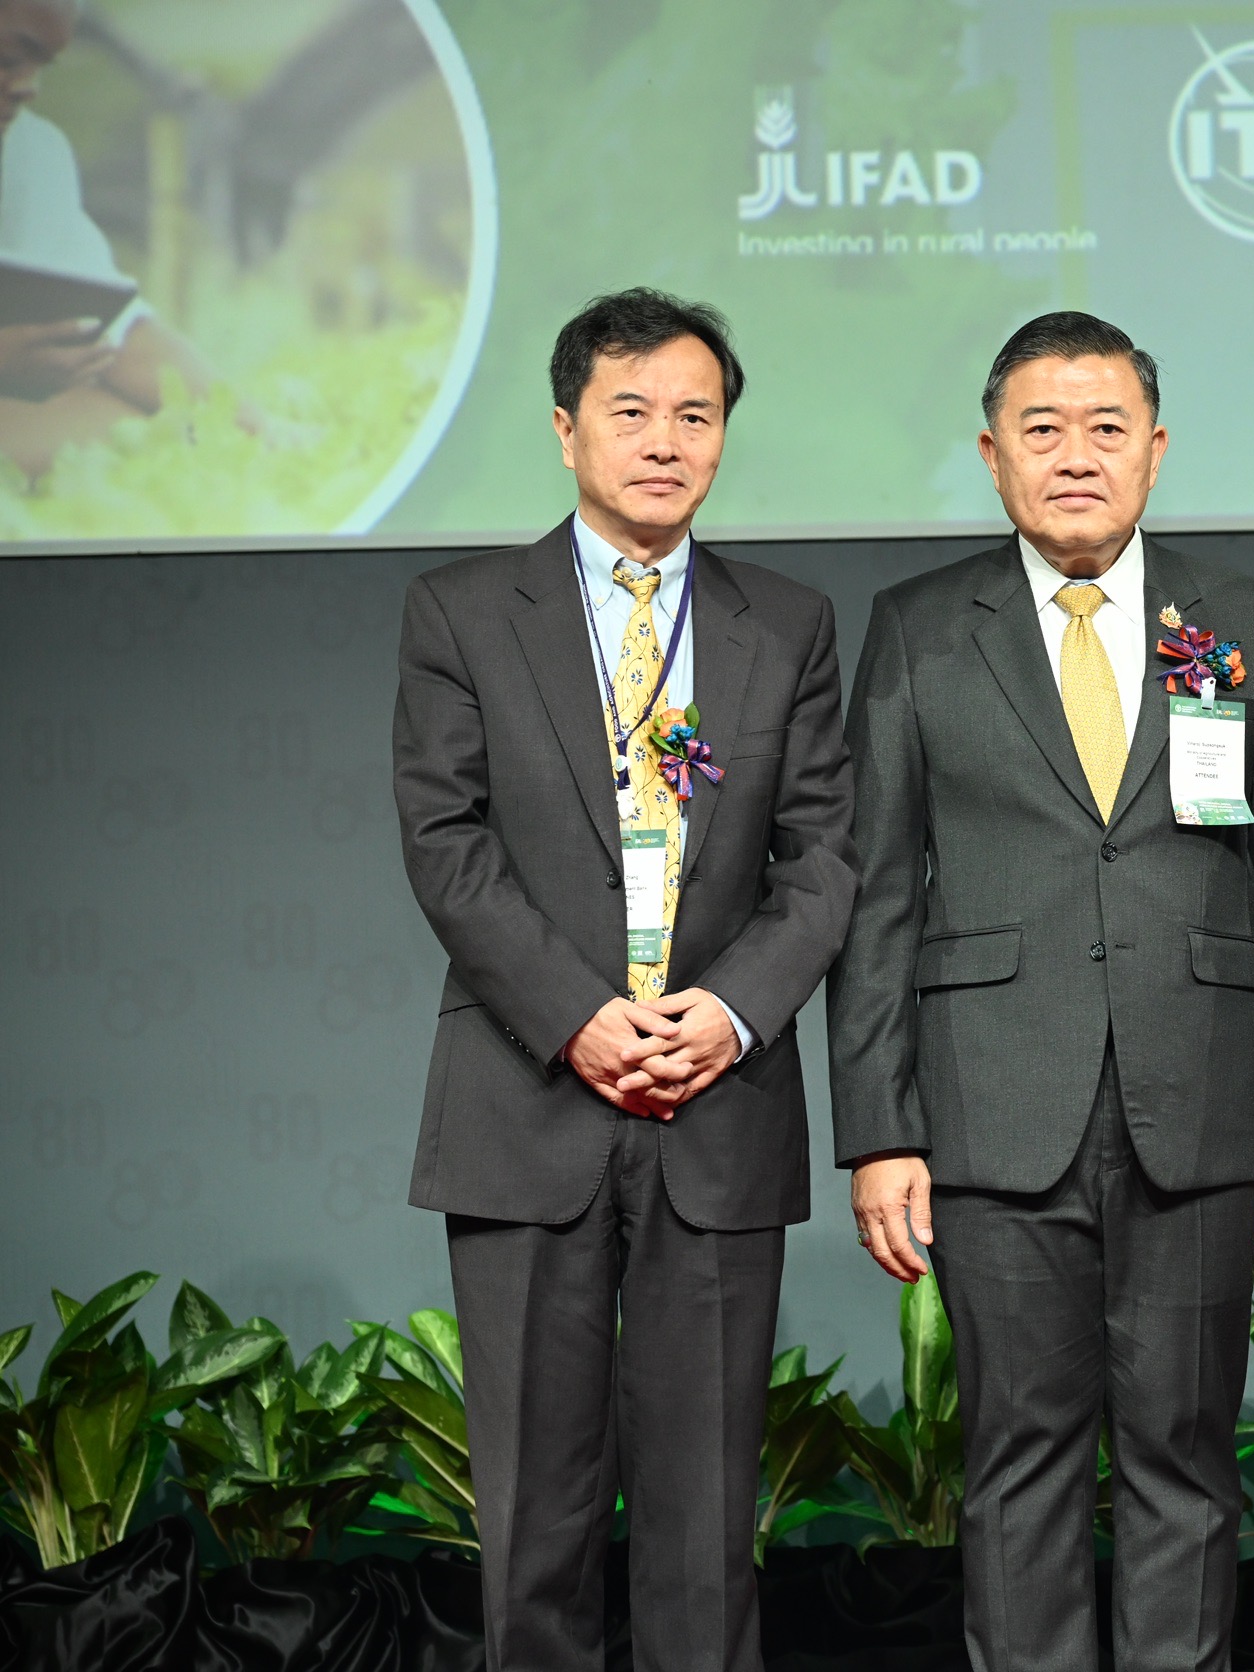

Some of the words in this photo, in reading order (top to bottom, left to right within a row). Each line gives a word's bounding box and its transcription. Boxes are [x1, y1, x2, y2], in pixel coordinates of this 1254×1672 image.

[826, 151, 982, 206] IFAD
[884, 229, 908, 253] in
[917, 227, 984, 252] rural
